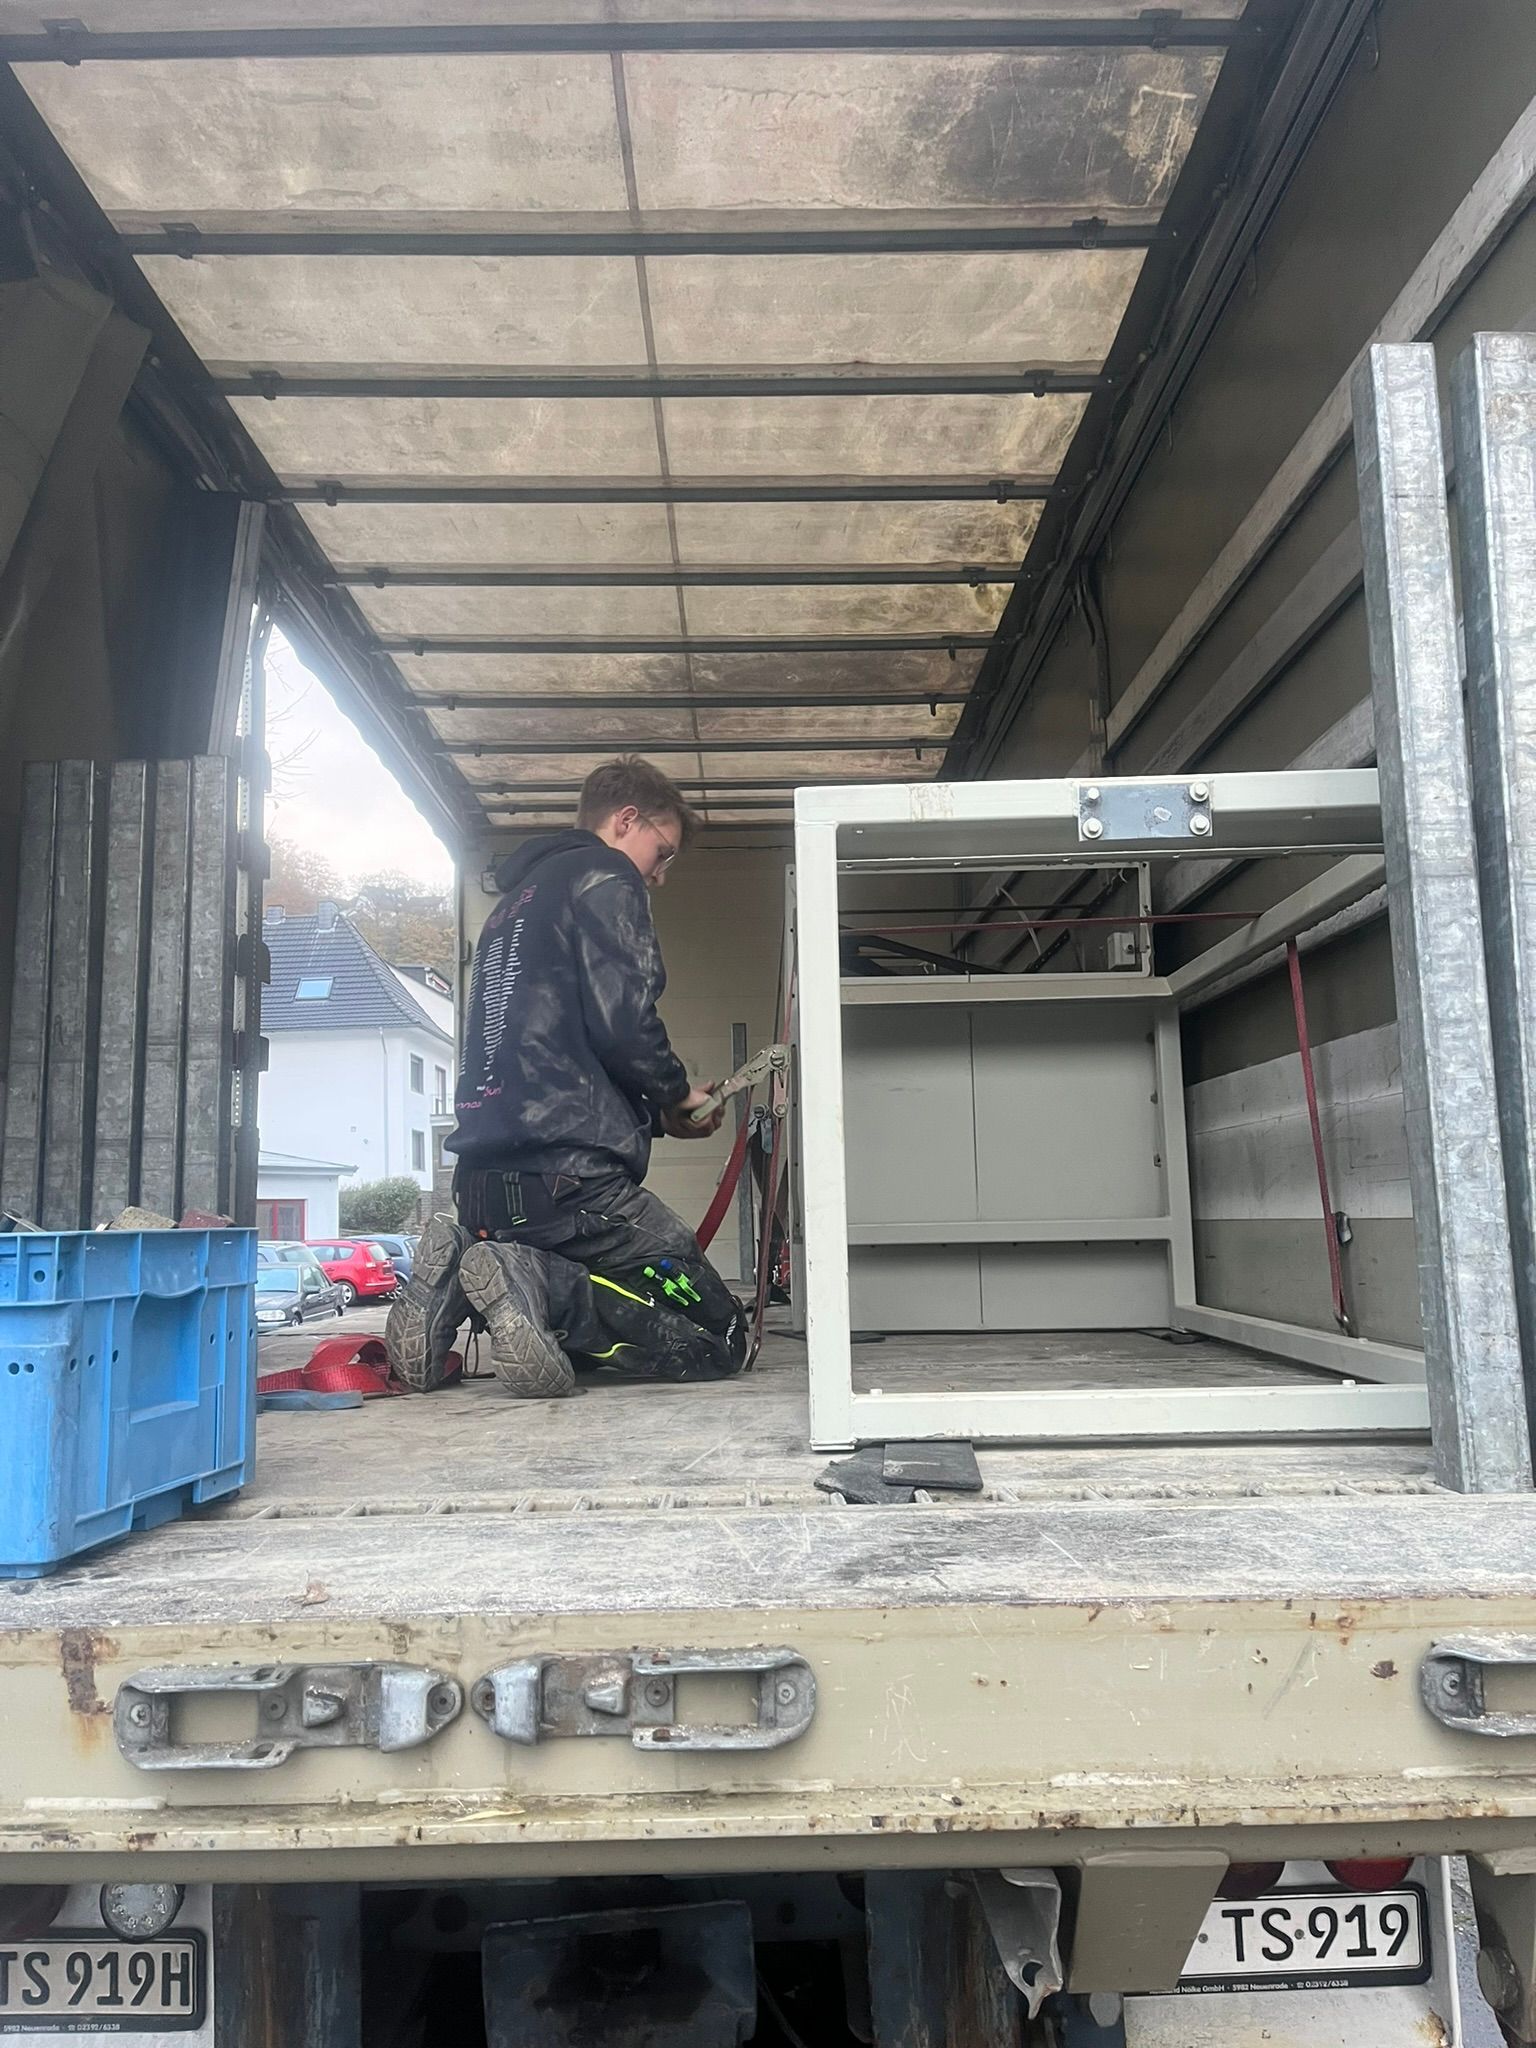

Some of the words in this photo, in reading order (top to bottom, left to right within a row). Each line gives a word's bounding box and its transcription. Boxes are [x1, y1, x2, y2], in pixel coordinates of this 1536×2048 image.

[1222, 1907, 1294, 1962] TS
[1308, 1903, 1409, 1959] 919
[66, 1951, 190, 2006] 919H
[1202, 1984, 1225, 1992] GmbH
